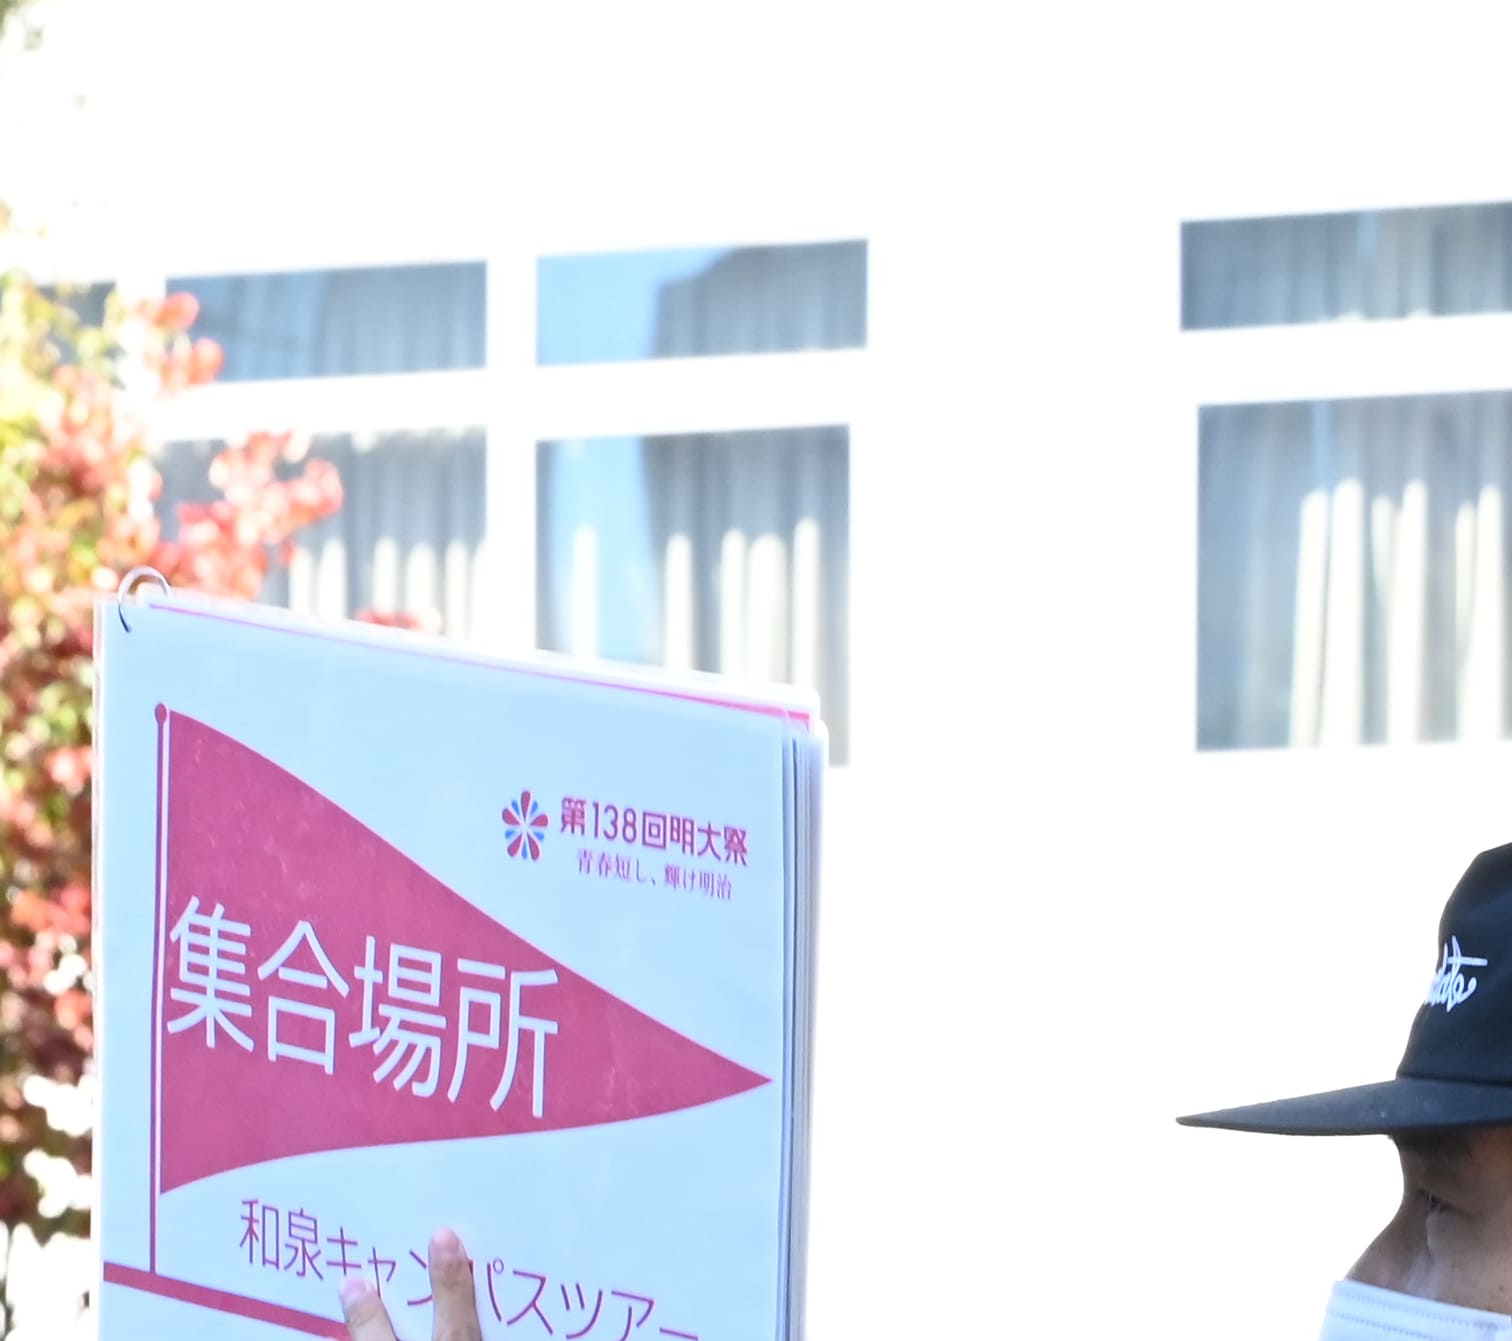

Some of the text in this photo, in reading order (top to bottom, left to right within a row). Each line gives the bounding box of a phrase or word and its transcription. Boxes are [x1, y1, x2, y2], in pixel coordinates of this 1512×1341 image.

[560, 797, 748, 867] 第138回明大祭
[577, 849, 732, 901] 青春短し、輝け明治
[166, 895, 562, 1119] 集合場所
